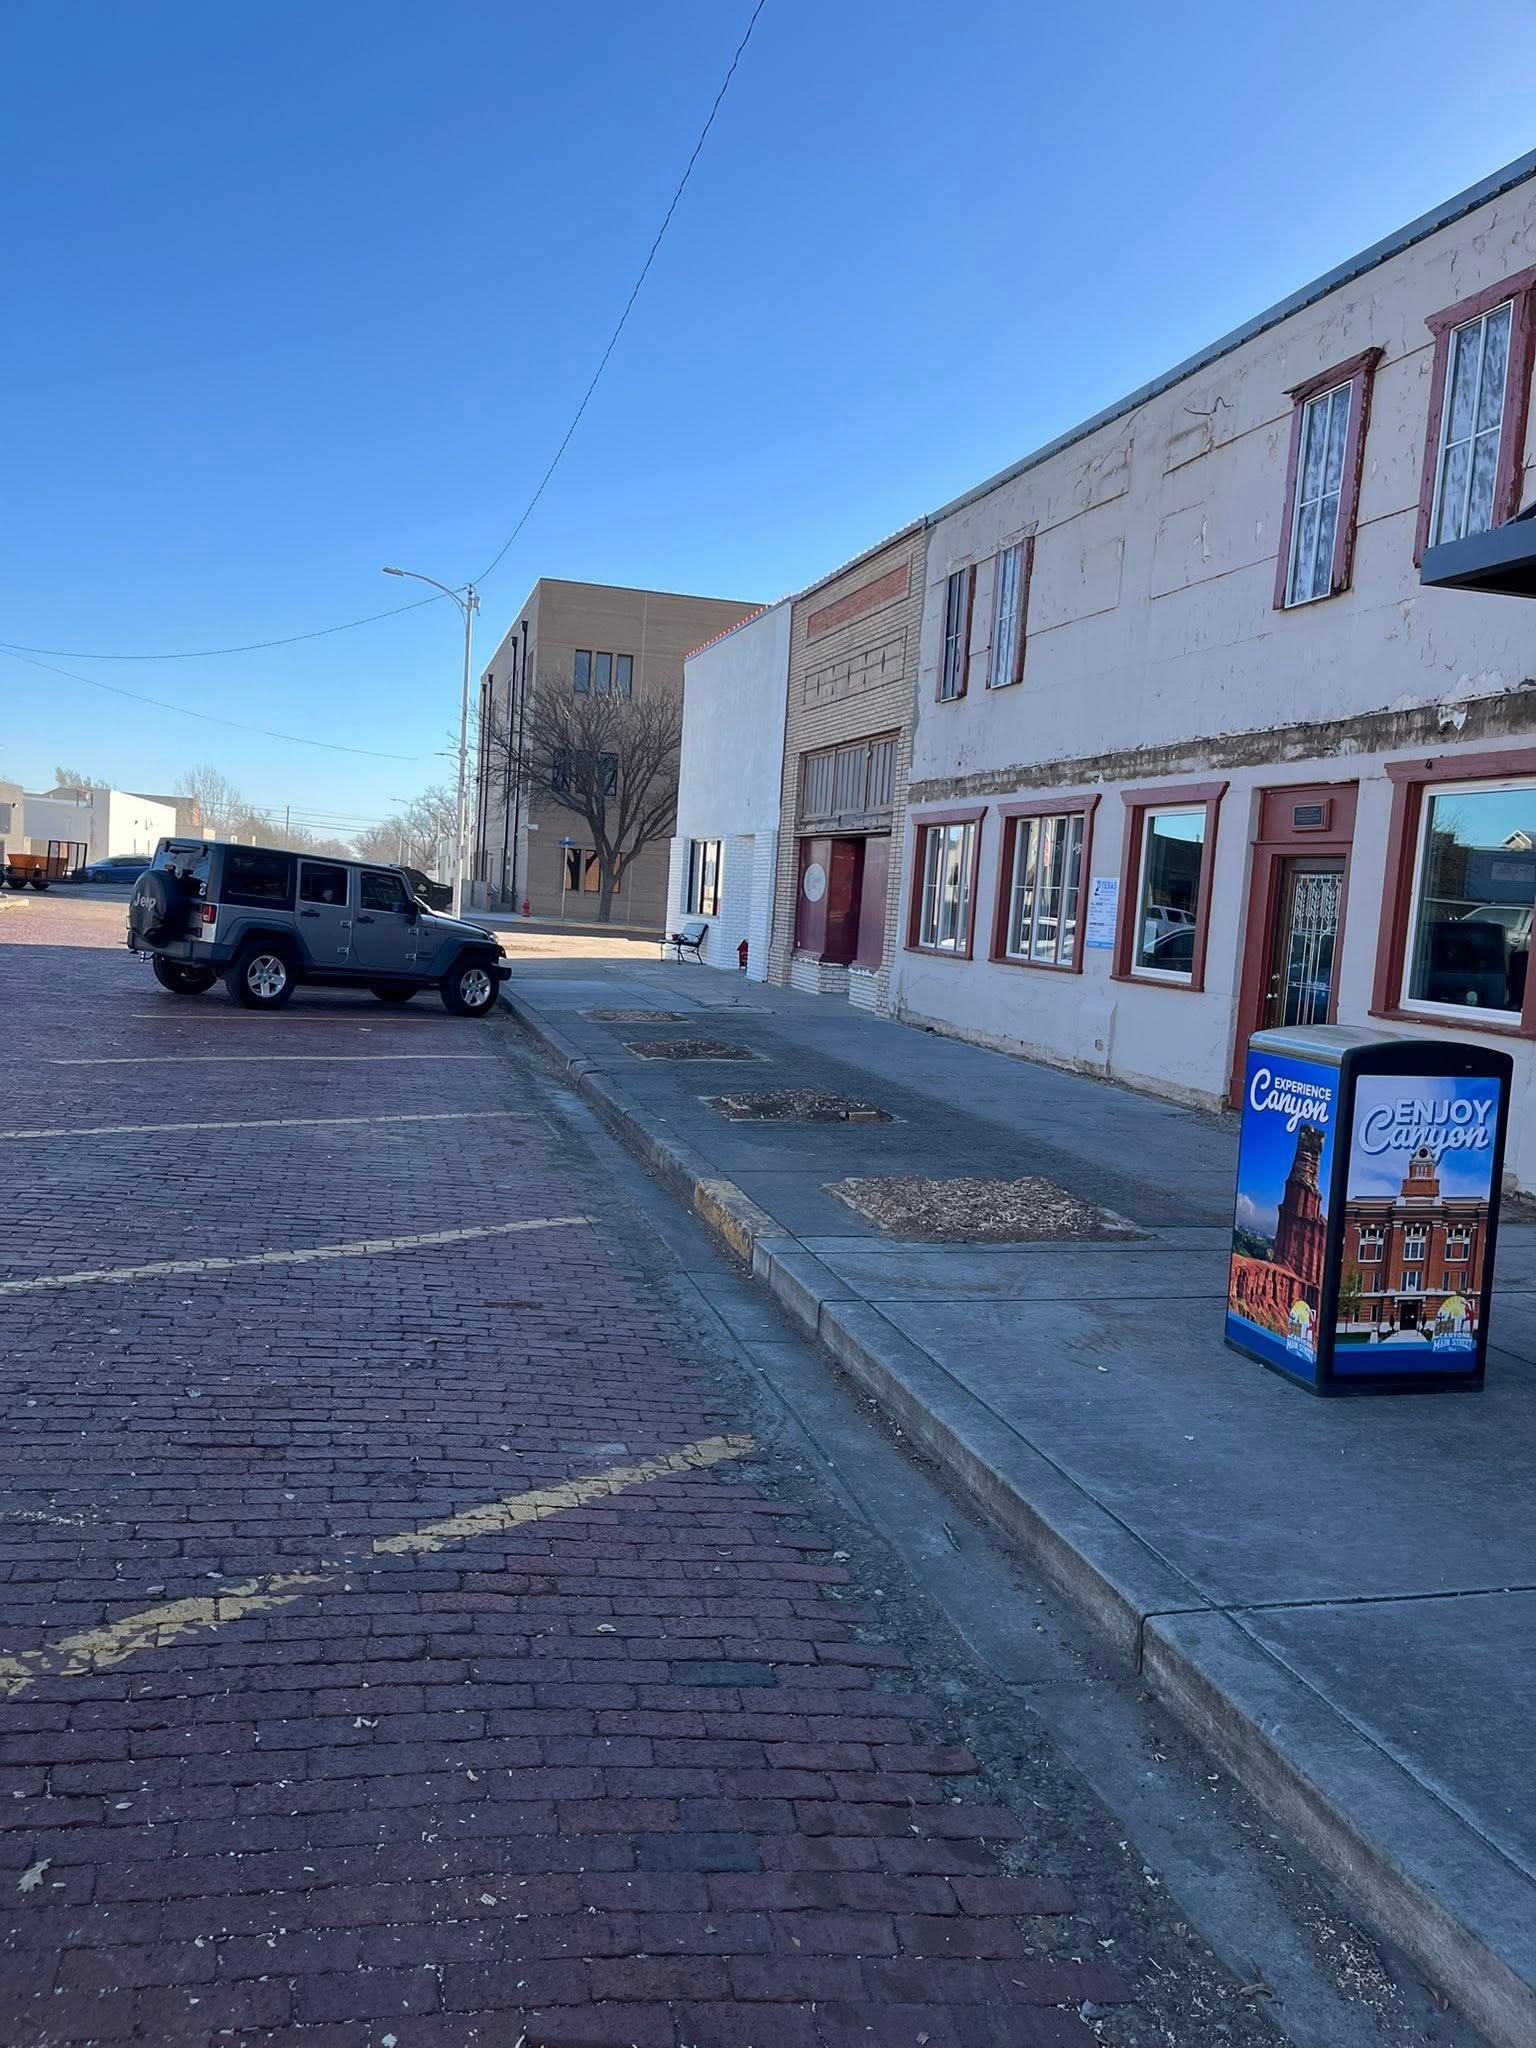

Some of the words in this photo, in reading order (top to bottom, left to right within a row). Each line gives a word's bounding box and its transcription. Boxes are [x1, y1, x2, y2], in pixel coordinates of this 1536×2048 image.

[134, 893, 156, 911] Jeep
[1250, 1068, 1329, 1132] Canyon
[1274, 1077, 1332, 1100] EXPERIENCE
[1395, 1099, 1492, 1125] ENJOY
[1359, 1104, 1489, 1166] Canyon
